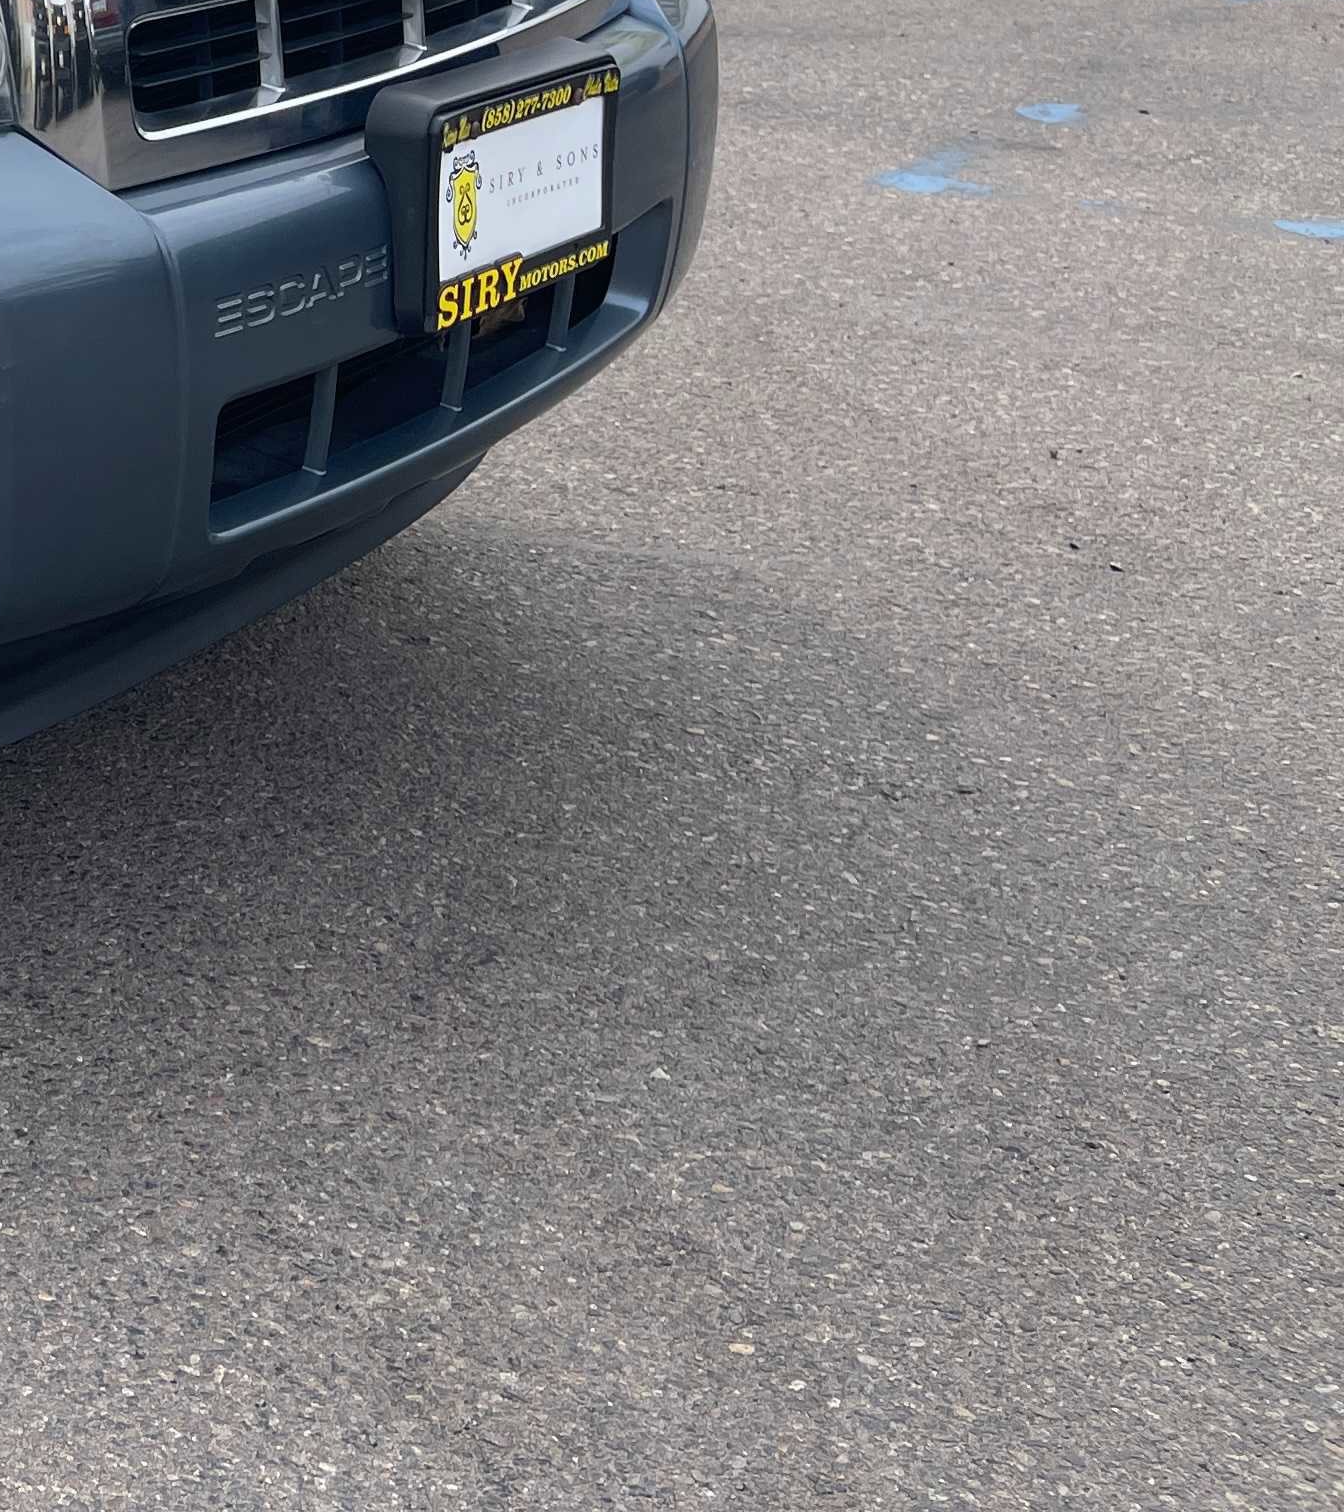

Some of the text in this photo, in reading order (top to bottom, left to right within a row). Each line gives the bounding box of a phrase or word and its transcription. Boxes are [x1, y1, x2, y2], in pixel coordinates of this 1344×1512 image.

[481, 98, 515, 132] (858)
[515, 85, 572, 120] 277-7300
[489, 143, 599, 194] SIRY & SONS
[214, 242, 389, 338] ESCAPE
[437, 240, 609, 331] SIRY MOTORS.COM
